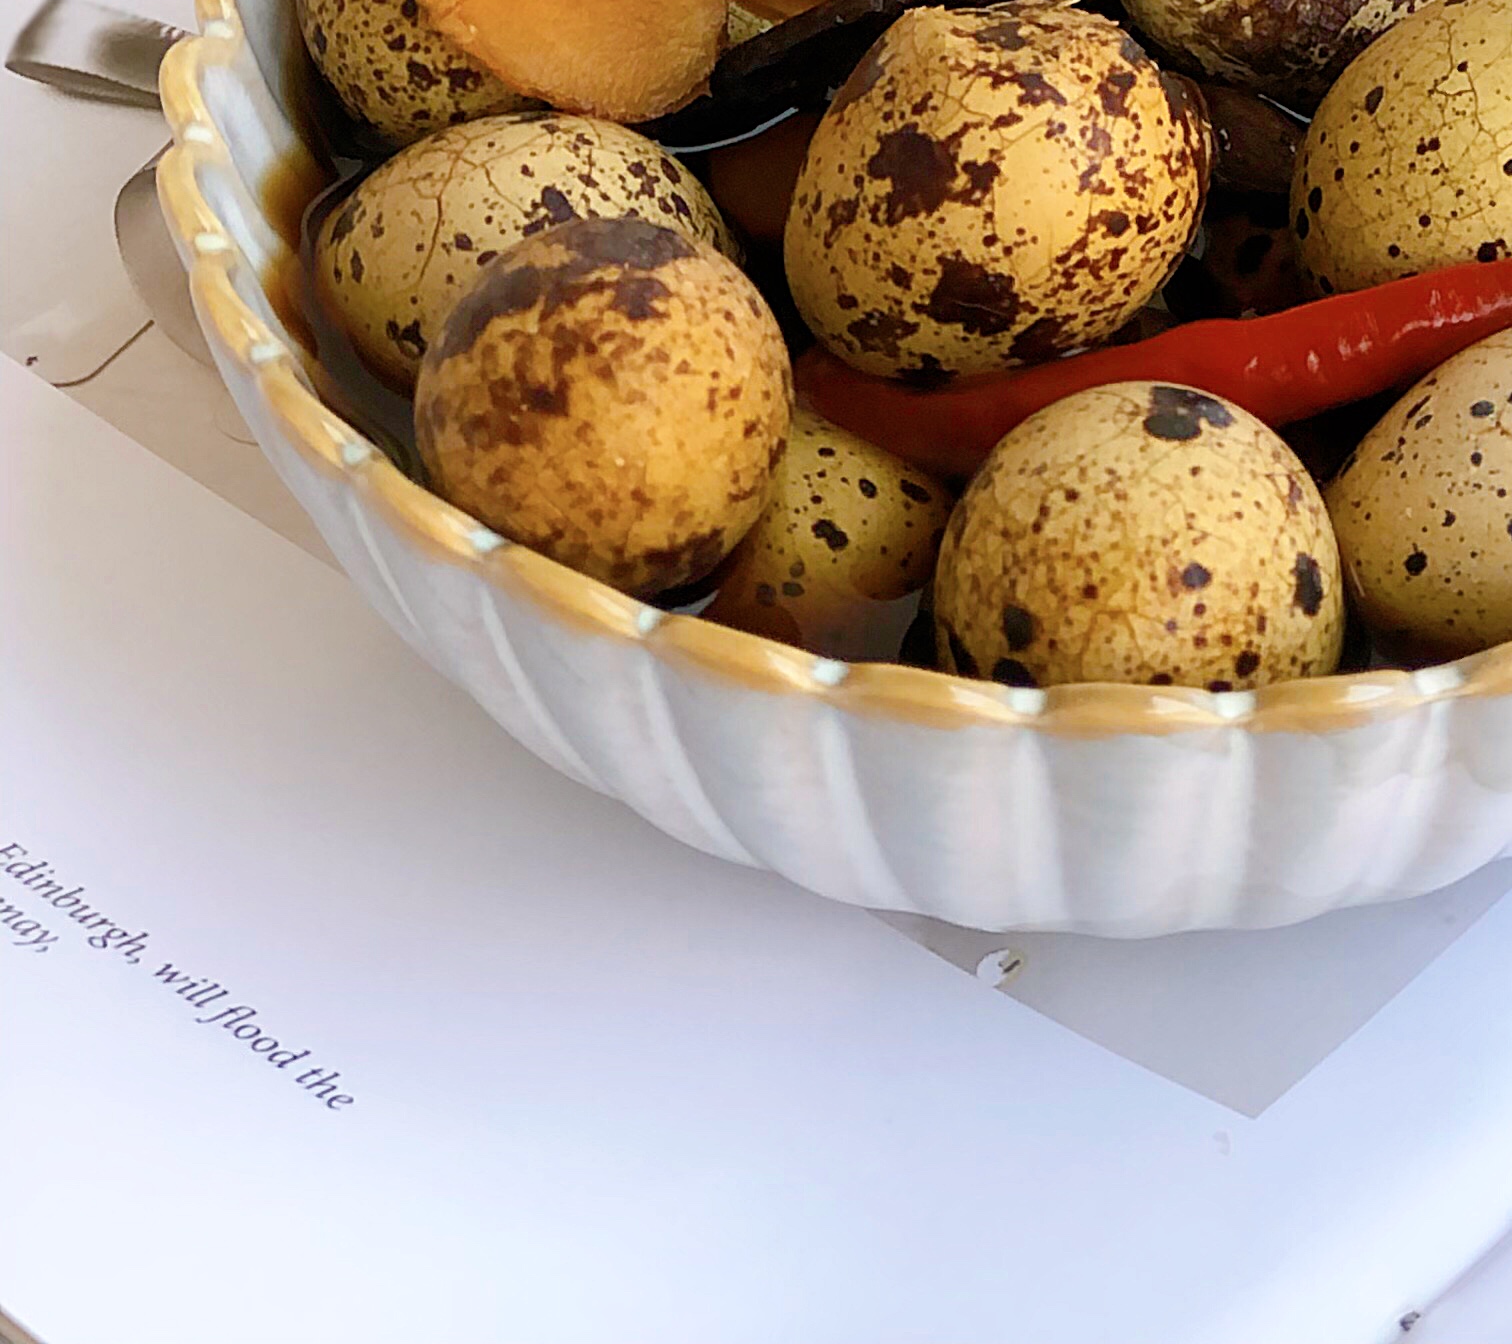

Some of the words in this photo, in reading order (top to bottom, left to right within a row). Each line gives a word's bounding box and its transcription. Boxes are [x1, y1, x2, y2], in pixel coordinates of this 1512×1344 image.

[0, 898, 59, 952] nay,
[0, 843, 149, 964] Edinburgh,
[153, 962, 228, 1009] will
[195, 1005, 311, 1069] flood
[295, 1067, 354, 1110] the
